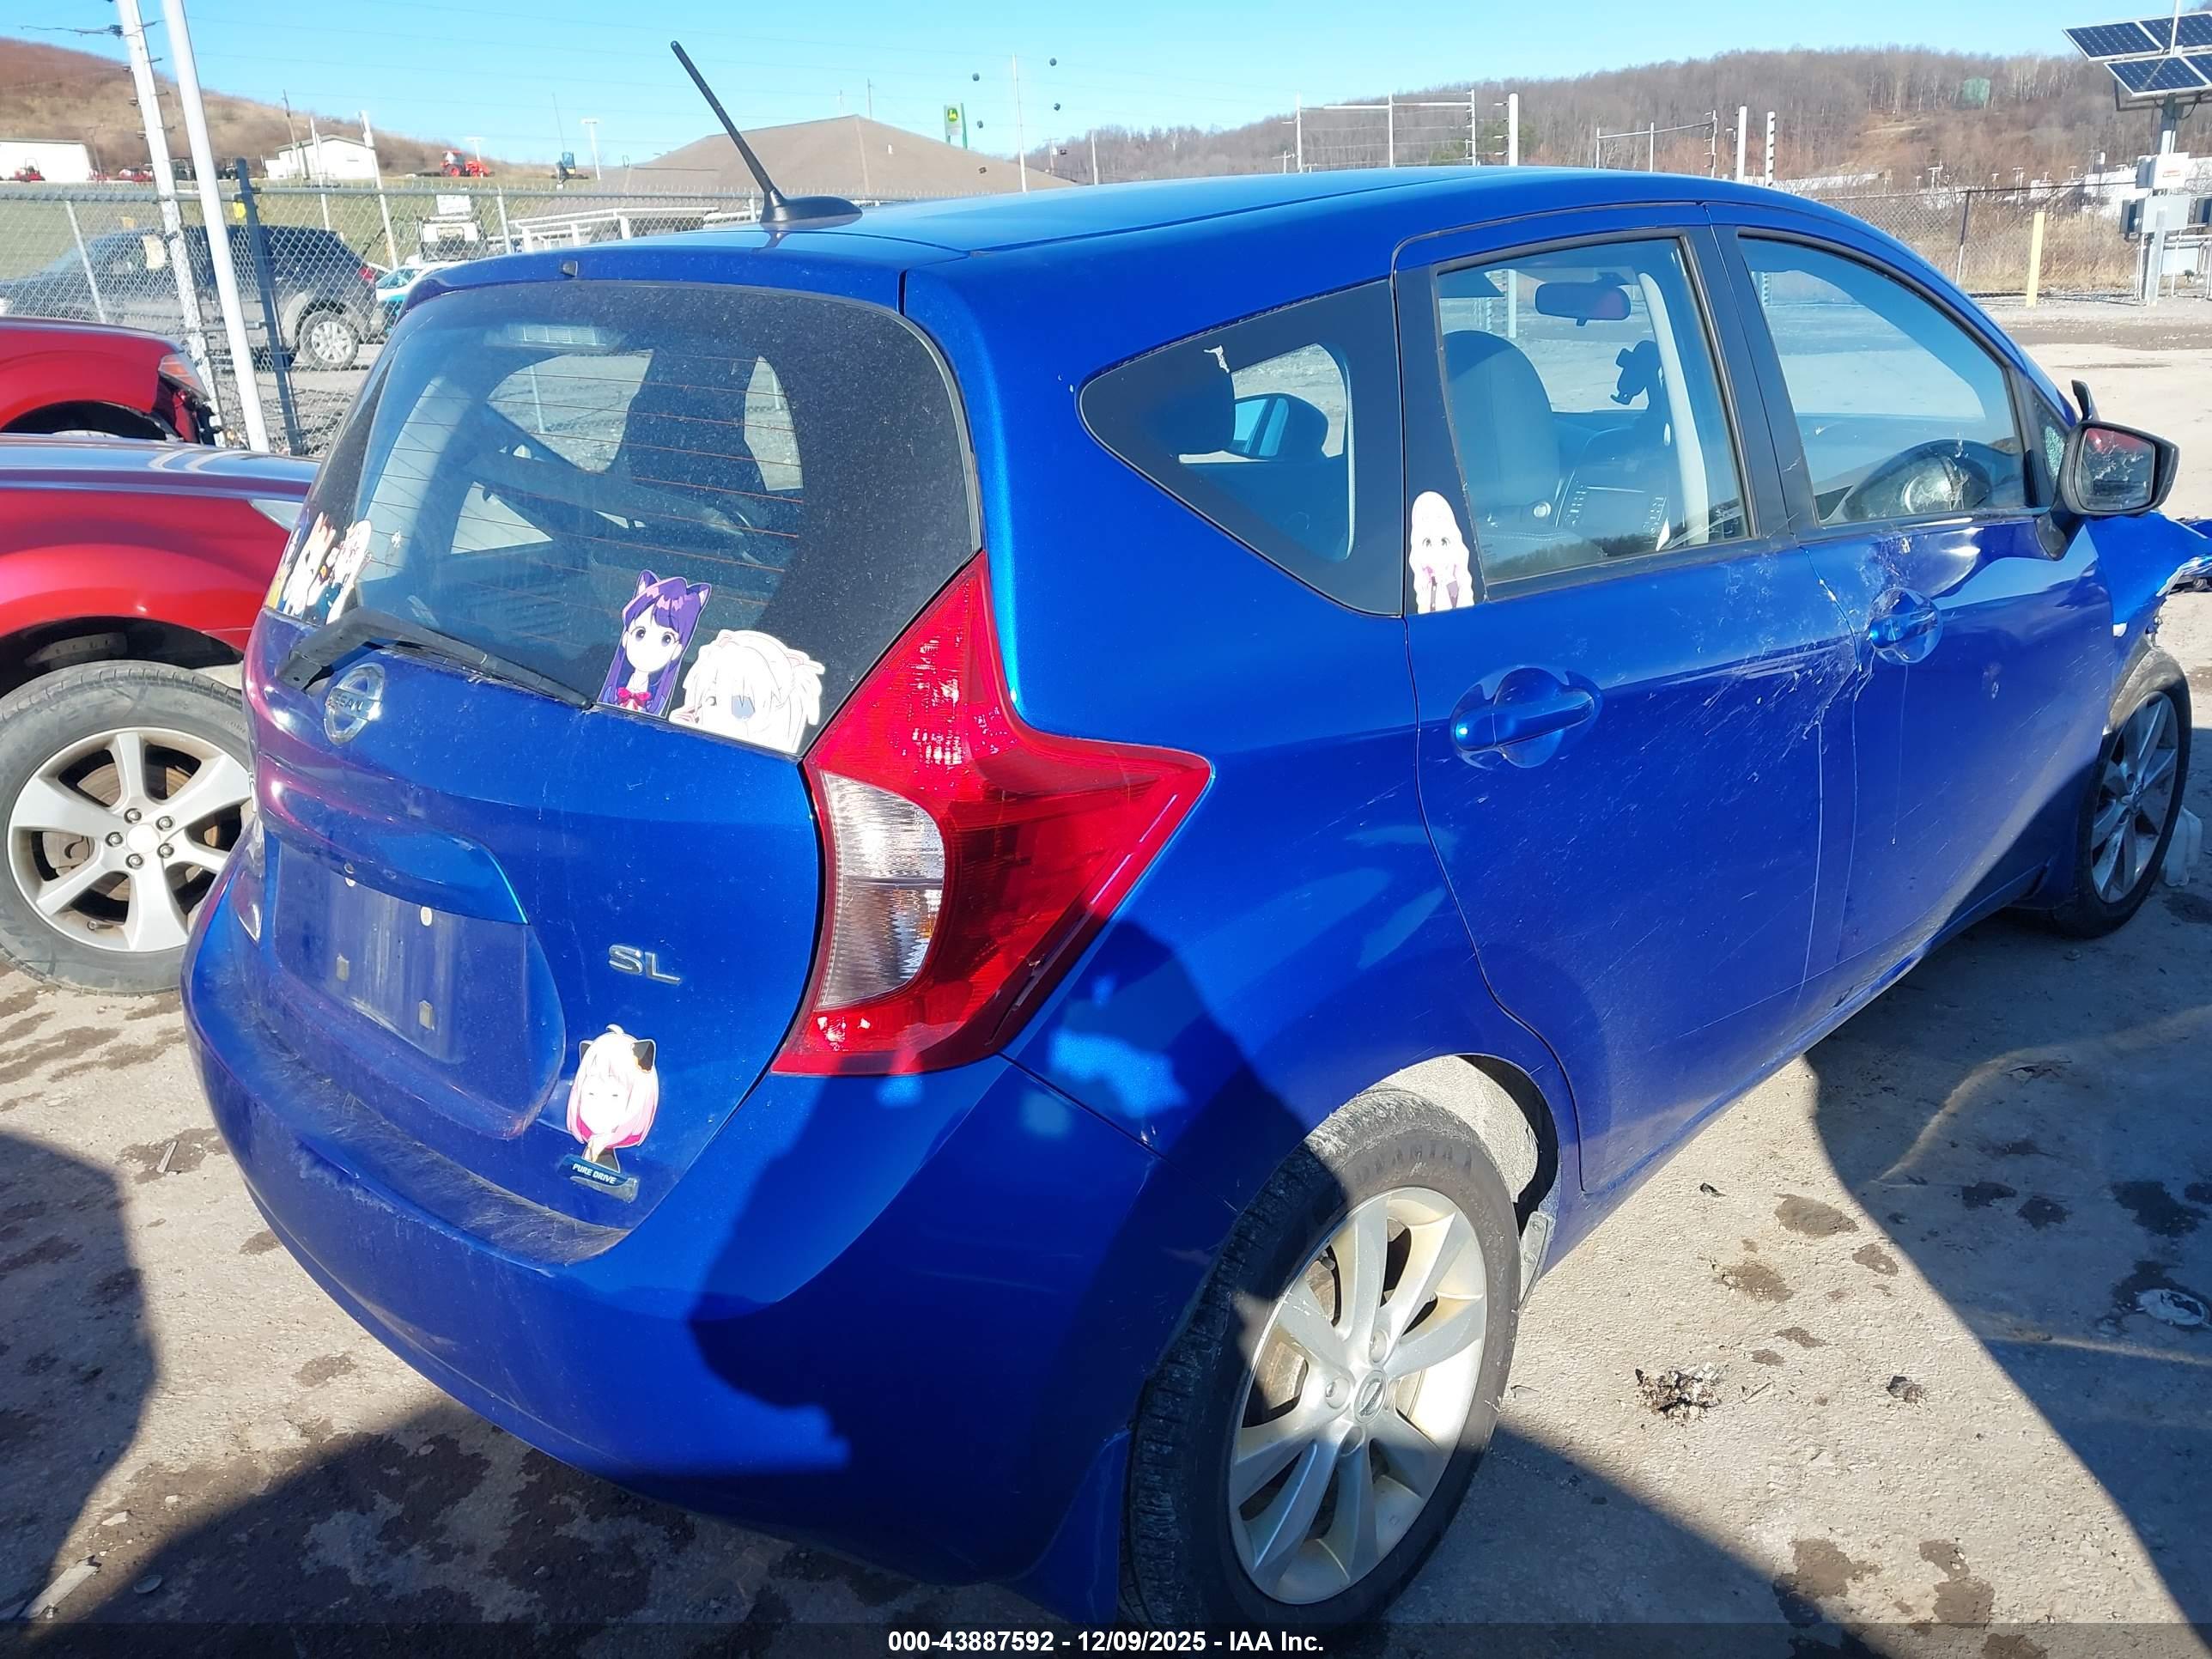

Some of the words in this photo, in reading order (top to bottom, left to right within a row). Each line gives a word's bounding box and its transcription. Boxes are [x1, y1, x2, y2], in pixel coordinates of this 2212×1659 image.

[609, 945, 682, 986] SL
[572, 1163, 593, 1176] PURE
[592, 1170, 617, 1184] DRIVE
